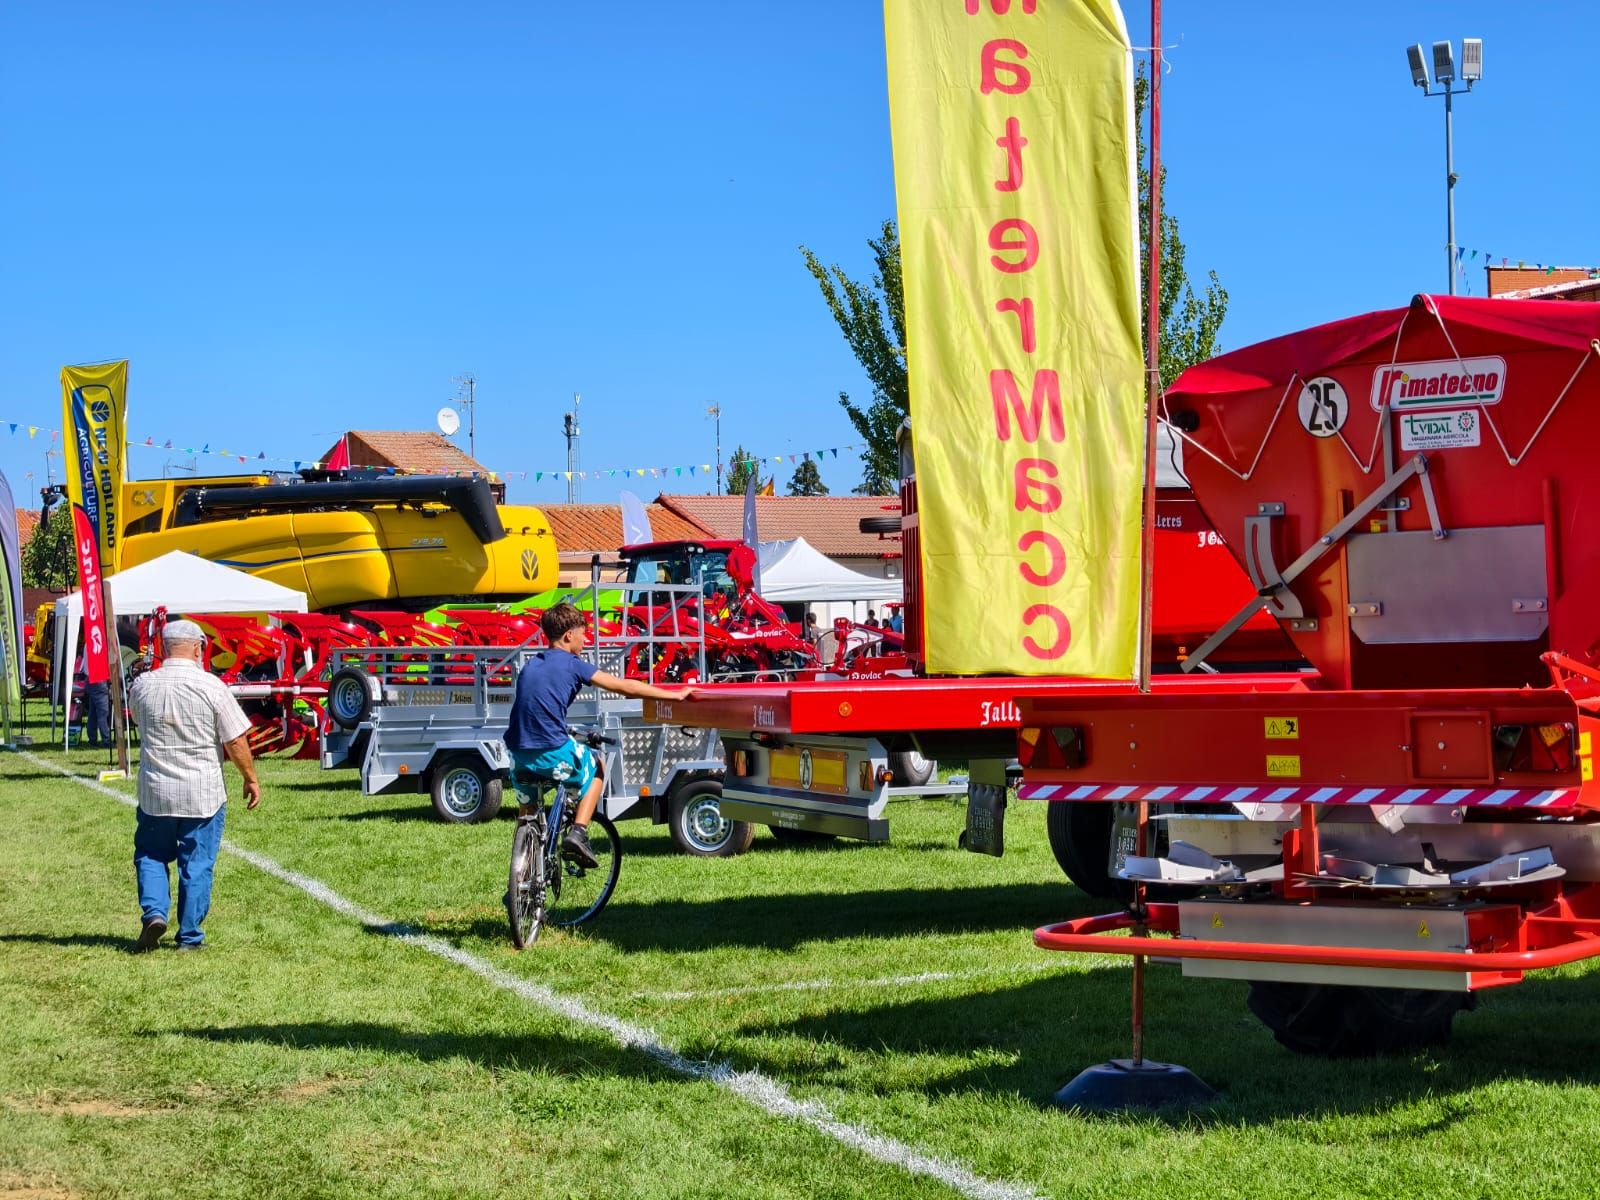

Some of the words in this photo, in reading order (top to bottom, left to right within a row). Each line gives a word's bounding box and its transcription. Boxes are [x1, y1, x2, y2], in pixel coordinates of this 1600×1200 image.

[1308, 382, 1338, 431] 25
[77, 427, 98, 522] AGRICULTURE
[100, 469, 117, 550] HOLLAND
[860, 670, 882, 680] ovlac
